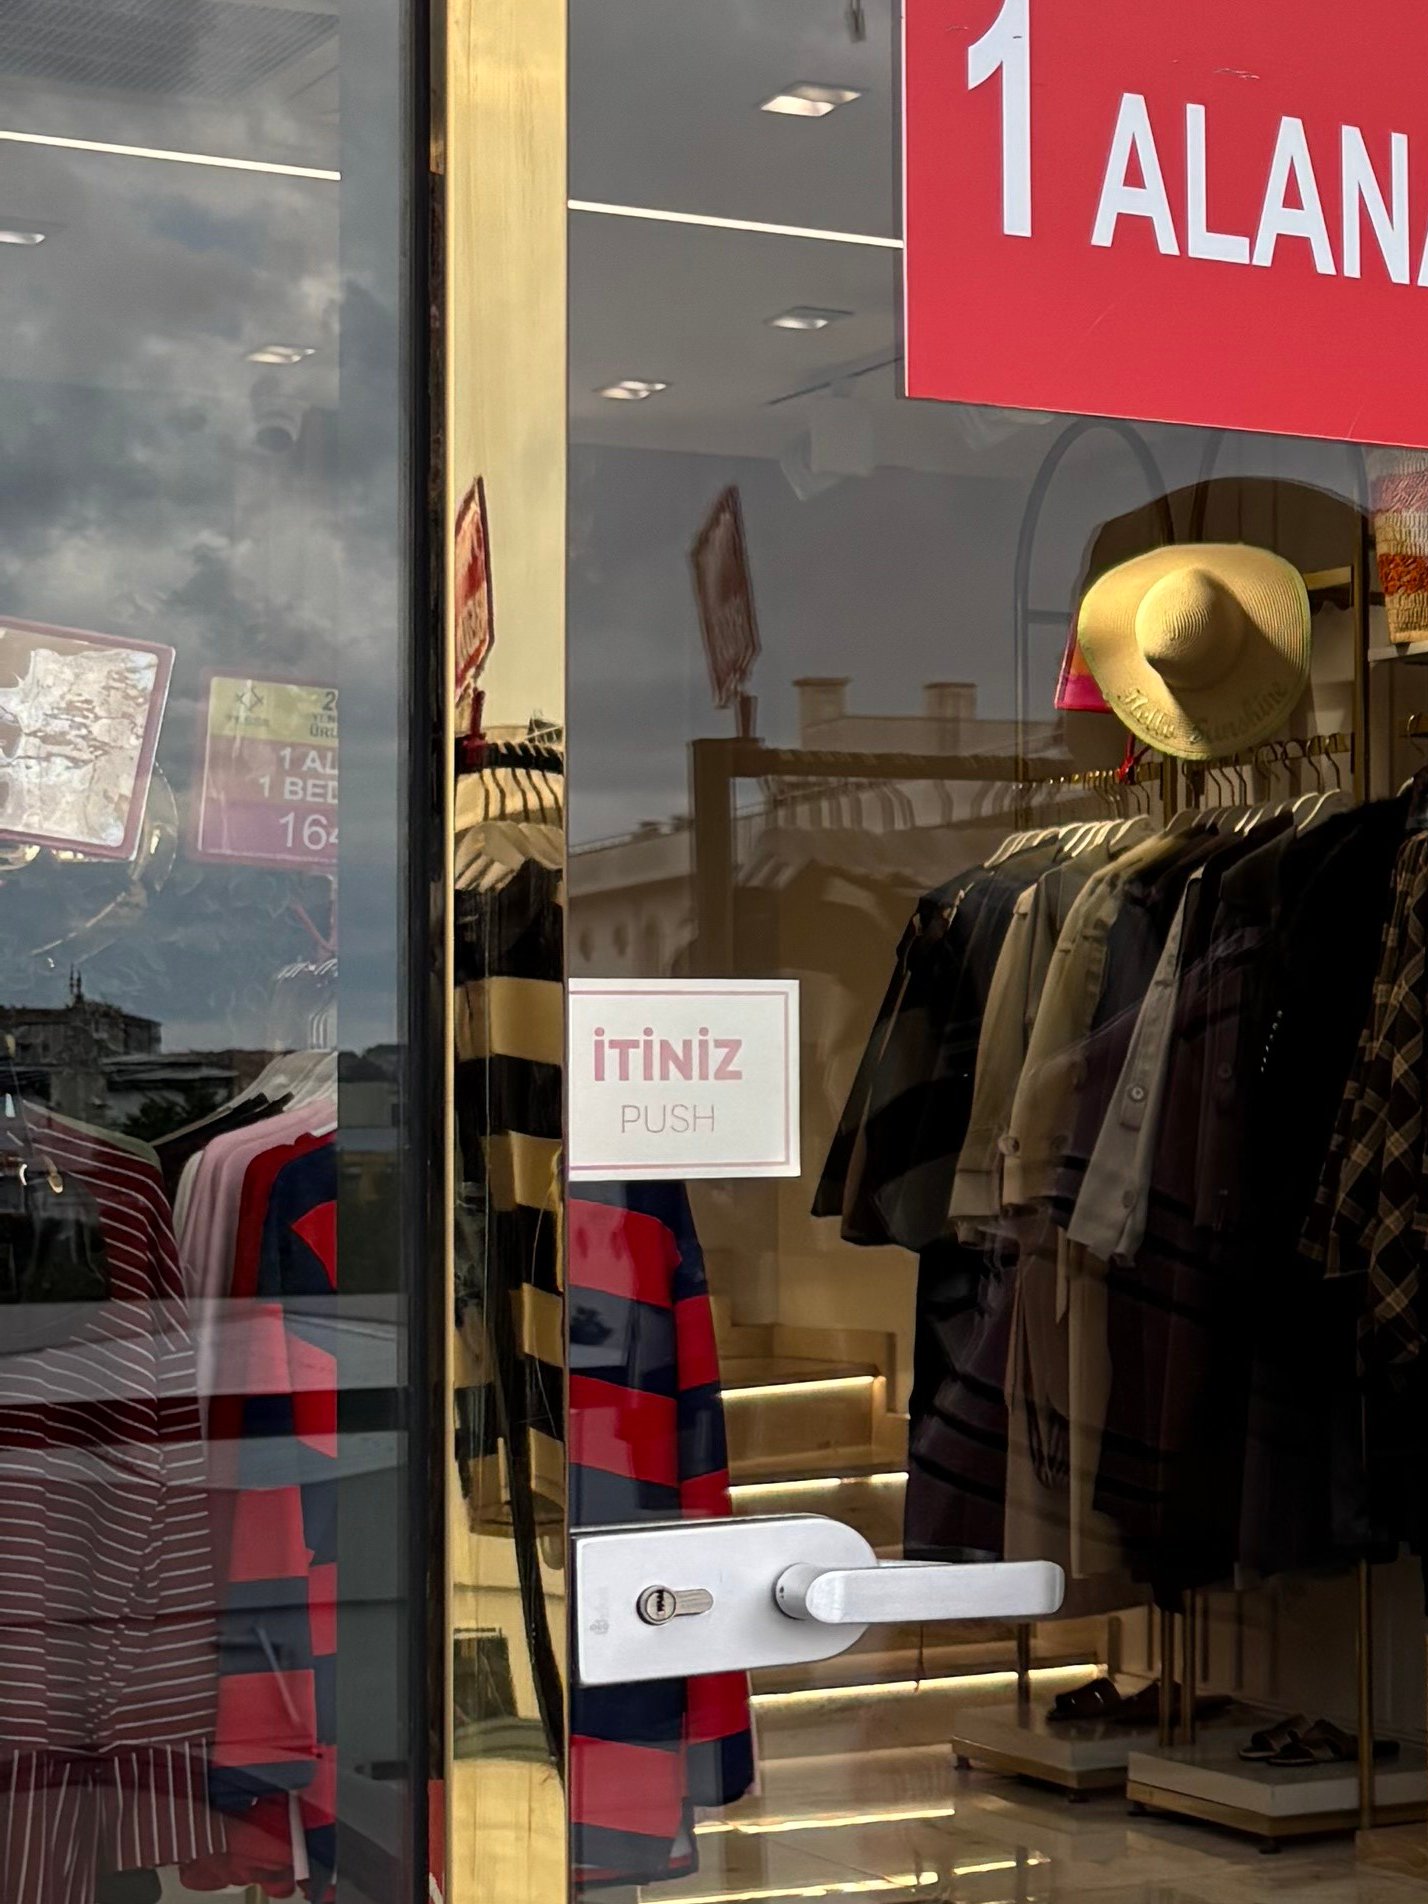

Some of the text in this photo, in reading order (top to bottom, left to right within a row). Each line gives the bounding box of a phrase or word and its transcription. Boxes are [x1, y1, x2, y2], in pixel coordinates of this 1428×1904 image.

[280, 747, 292, 771] 1
[258, 774, 271, 799] 1
[593, 1026, 743, 1082] İTİNİZ
[620, 1103, 715, 1134] PUSH
